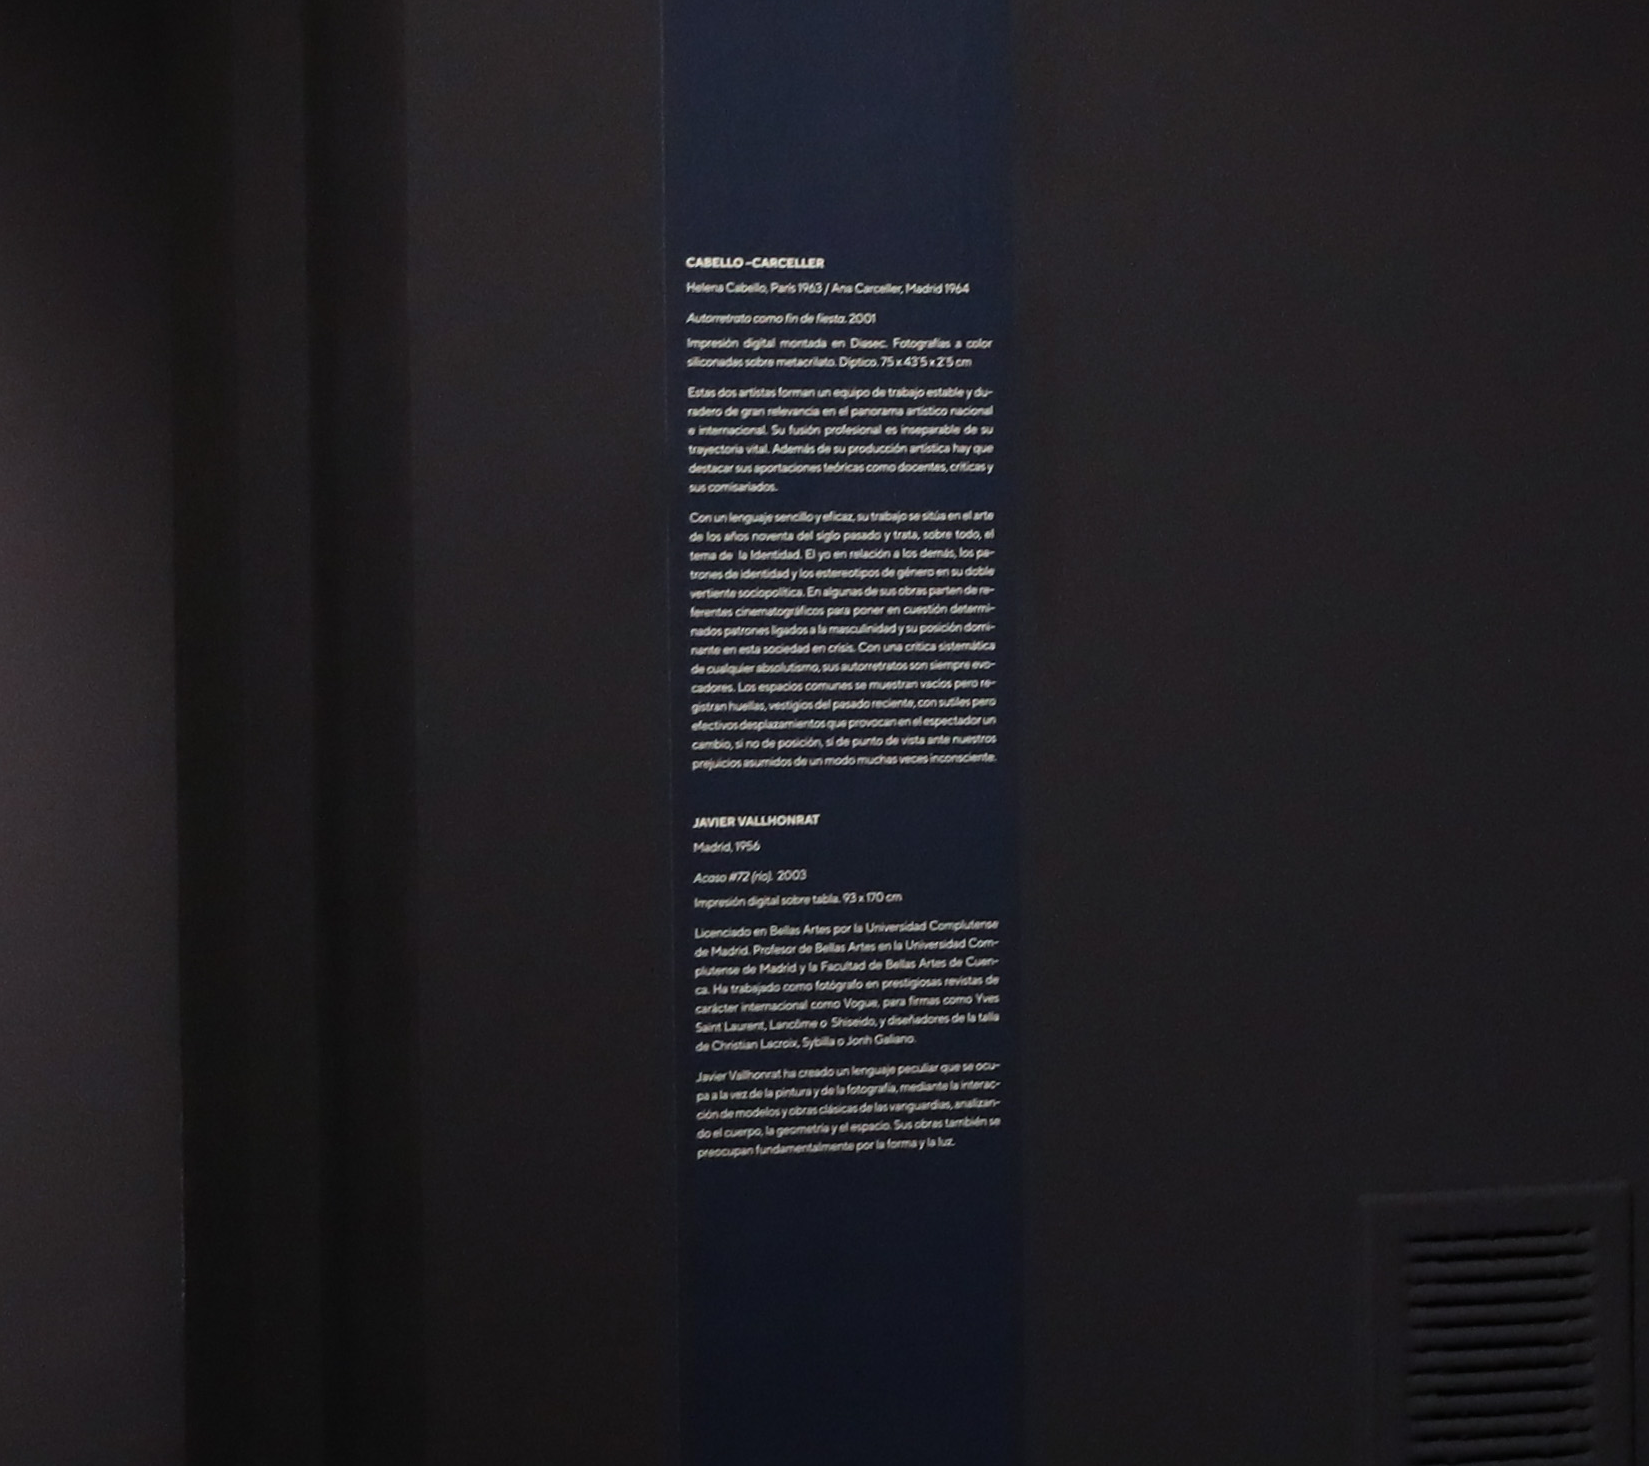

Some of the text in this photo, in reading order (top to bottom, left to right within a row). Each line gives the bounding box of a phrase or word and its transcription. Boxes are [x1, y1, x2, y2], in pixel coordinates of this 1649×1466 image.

[685, 256, 744, 268] CABELLO
[685, 281, 724, 293] Helena
[724, 281, 768, 293] Cabello,
[797, 281, 823, 294] 1963
[830, 282, 853, 293] Ana
[853, 282, 903, 294] Carceller,
[904, 282, 943, 294] Madrid
[944, 282, 970, 294] 1964
[685, 312, 876, 324] Autorretrato como fin de fiesta. 2001
[742, 337, 776, 350] digital
[779, 338, 827, 348] montada
[830, 339, 846, 348] en
[965, 337, 993, 349] color
[686, 356, 744, 367] siliconadas
[743, 356, 775, 367] sobre
[775, 356, 837, 367] metacrilato.
[879, 355, 895, 367] 75
[954, 358, 972, 367] cm
[686, 385, 716, 398] Estas
[717, 387, 737, 398] dos
[737, 387, 777, 398] artistas
[777, 387, 816, 398] forman
[816, 388, 832, 398] un
[832, 388, 871, 399] equipo
[871, 386, 887, 397] de
[887, 387, 925, 399] trabajo
[925, 387, 965, 397] estable
[973, 386, 993, 397] du-
[686, 406, 723, 417] radero
[723, 405, 740, 417] de
[739, 407, 766, 419] gran
[766, 406, 821, 416] relevancia
[821, 407, 837, 416] en
[850, 407, 904, 418] panorama
[949, 405, 994, 416] nacional
[697, 425, 769, 436] internacional.
[770, 423, 786, 436] Su
[823, 424, 882, 437] profesional
[899, 424, 961, 437] inseparable
[962, 423, 978, 435] de
[687, 444, 744, 457] trayectoria
[745, 443, 770, 454] vital.
[816, 442, 832, 454] de
[951, 442, 972, 456] hay
[972, 444, 994, 456] que
[687, 481, 778, 493] sus comisariados.
[688, 531, 704, 542] de
[705, 530, 722, 542] los
[750, 532, 794, 541] noventa
[795, 529, 814, 541] del
[815, 529, 841, 543] siglo
[842, 530, 882, 543] pasado
[892, 529, 921, 540] trata,
[922, 529, 953, 540] sobre
[954, 529, 982, 540] todo,
[689, 607, 733, 618] ferentes
[826, 606, 851, 617] para
[852, 606, 885, 617] poner
[885, 605, 901, 615] en
[949, 602, 995, 614] determi-
[692, 813, 820, 828] JAVIER VALLHONRAT
[692, 841, 733, 853] Madrid,
[692, 872, 727, 884] Acaso
[776, 868, 807, 881] 2003
[746, 895, 780, 909] digital
[780, 895, 811, 905] sobre
[811, 892, 841, 905] tabla.
[841, 891, 857, 904] 93
[884, 893, 903, 902] cm
[693, 926, 752, 939] Licenciado
[752, 927, 768, 937] en
[768, 923, 801, 936] Bellas
[801, 923, 831, 935] Artes
[832, 924, 851, 937] por
[864, 920, 927, 933] Universidad
[928, 918, 999, 934] Complutense
[693, 946, 709, 958] de
[710, 944, 751, 957] Madrid.
[752, 943, 796, 956] Profesor
[797, 942, 813, 954] de
[814, 941, 846, 954] Bellas
[847, 940, 876, 952] Artes
[877, 942, 892, 952] en
[904, 938, 966, 950] Universidad
[967, 936, 999, 949] Com-
[694, 986, 710, 996] ca.
[712, 983, 729, 995] Ha
[729, 981, 781, 996] trabajado
[781, 982, 813, 992] como
[864, 979, 880, 989] en
[881, 976, 943, 991] prestigiosas
[943, 975, 983, 986] revistas
[984, 973, 999, 985] de
[739, 999, 809, 1012] internacional
[809, 1000, 841, 1010] como
[842, 996, 881, 1011] Vogue,
[881, 997, 906, 1009] para
[907, 994, 941, 1006] firmas
[942, 995, 973, 1005] como
[974, 992, 1000, 1004] Yves
